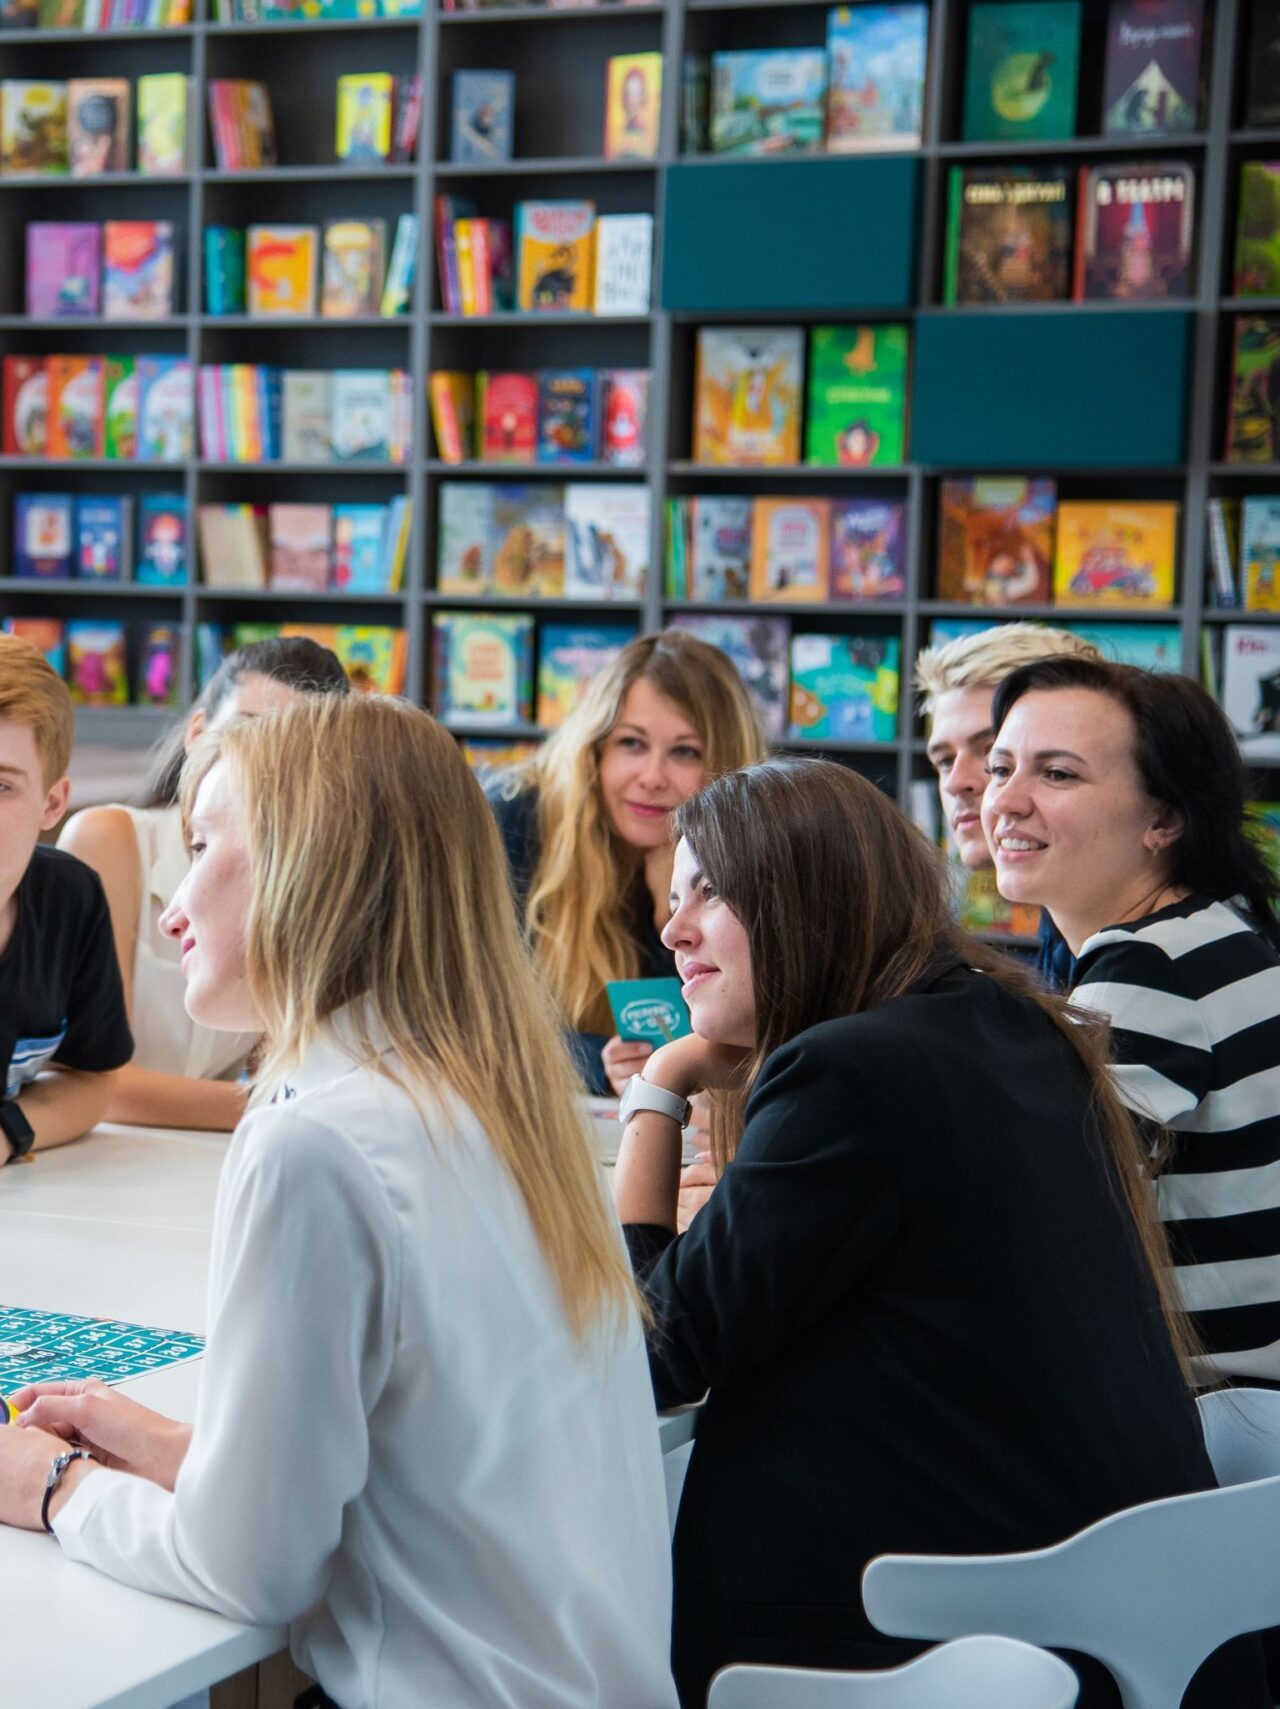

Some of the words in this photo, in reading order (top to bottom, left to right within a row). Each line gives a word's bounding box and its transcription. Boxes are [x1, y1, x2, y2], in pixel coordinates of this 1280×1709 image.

[1, 1321, 25, 1329] 34
[39, 1324, 66, 1334] 35
[79, 1331, 106, 1341] 36
[54, 1341, 79, 1352] 47
[123, 1337, 147, 1348] 37
[28, 1351, 55, 1359] 48
[95, 1350, 123, 1359] 38
[160, 1346, 188, 1356] 20
[69, 1357, 95, 1366] 39
[136, 1357, 161, 1365] 21
